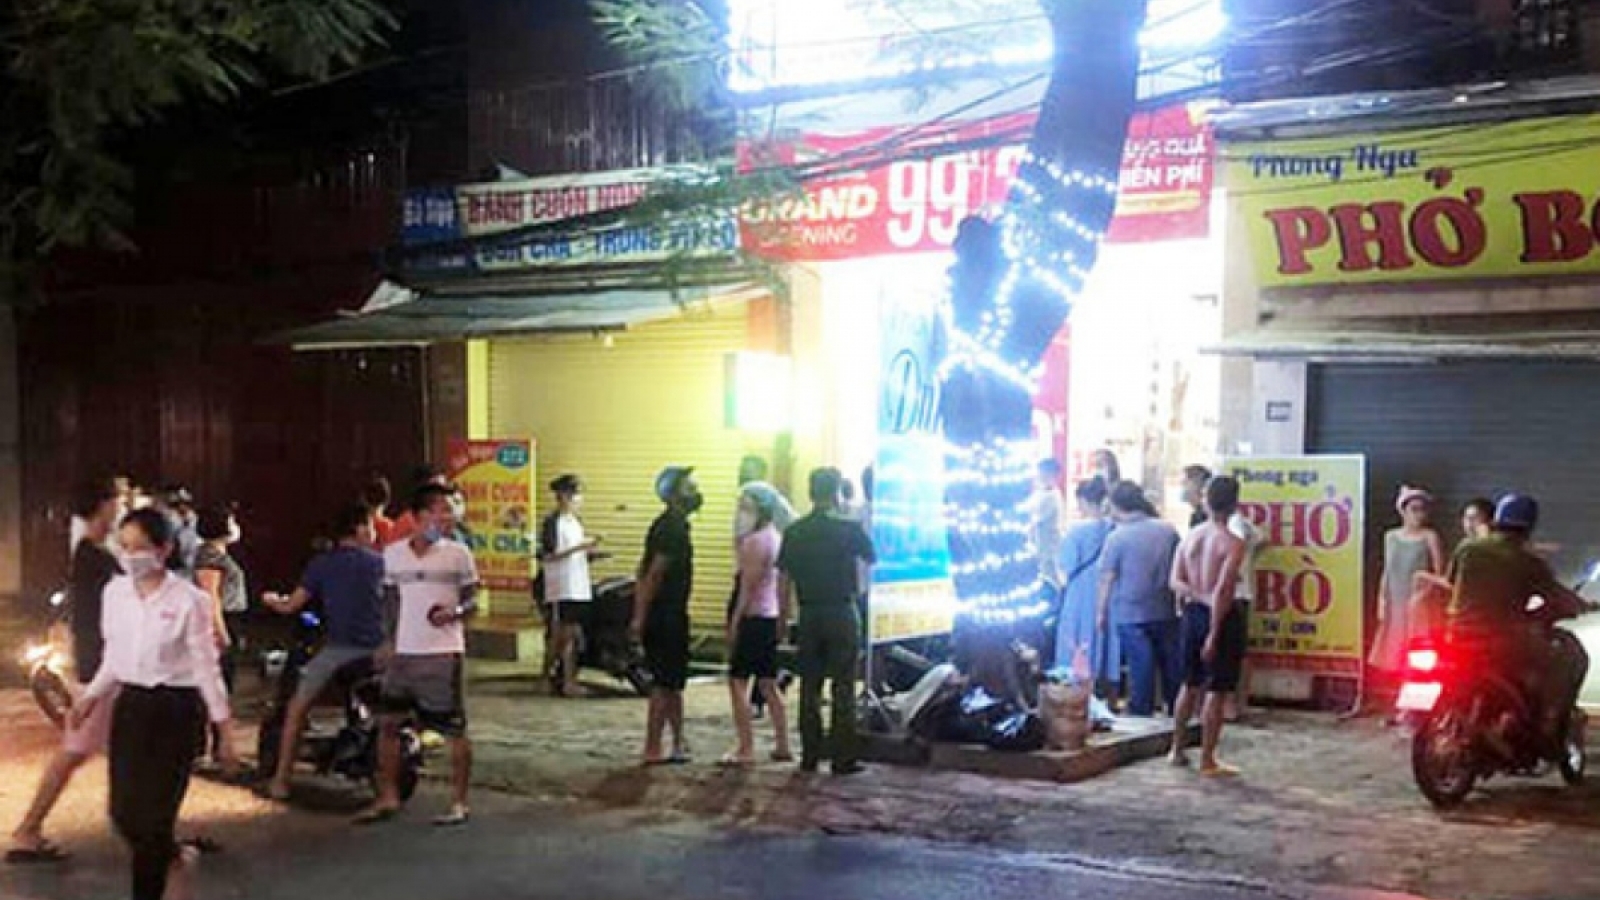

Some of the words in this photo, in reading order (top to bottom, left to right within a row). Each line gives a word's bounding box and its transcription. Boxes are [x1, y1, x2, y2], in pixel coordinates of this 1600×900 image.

[1264, 166, 1487, 275] PHỞ
[1512, 188, 1600, 264] B
[1256, 554, 1333, 617] BÒ
